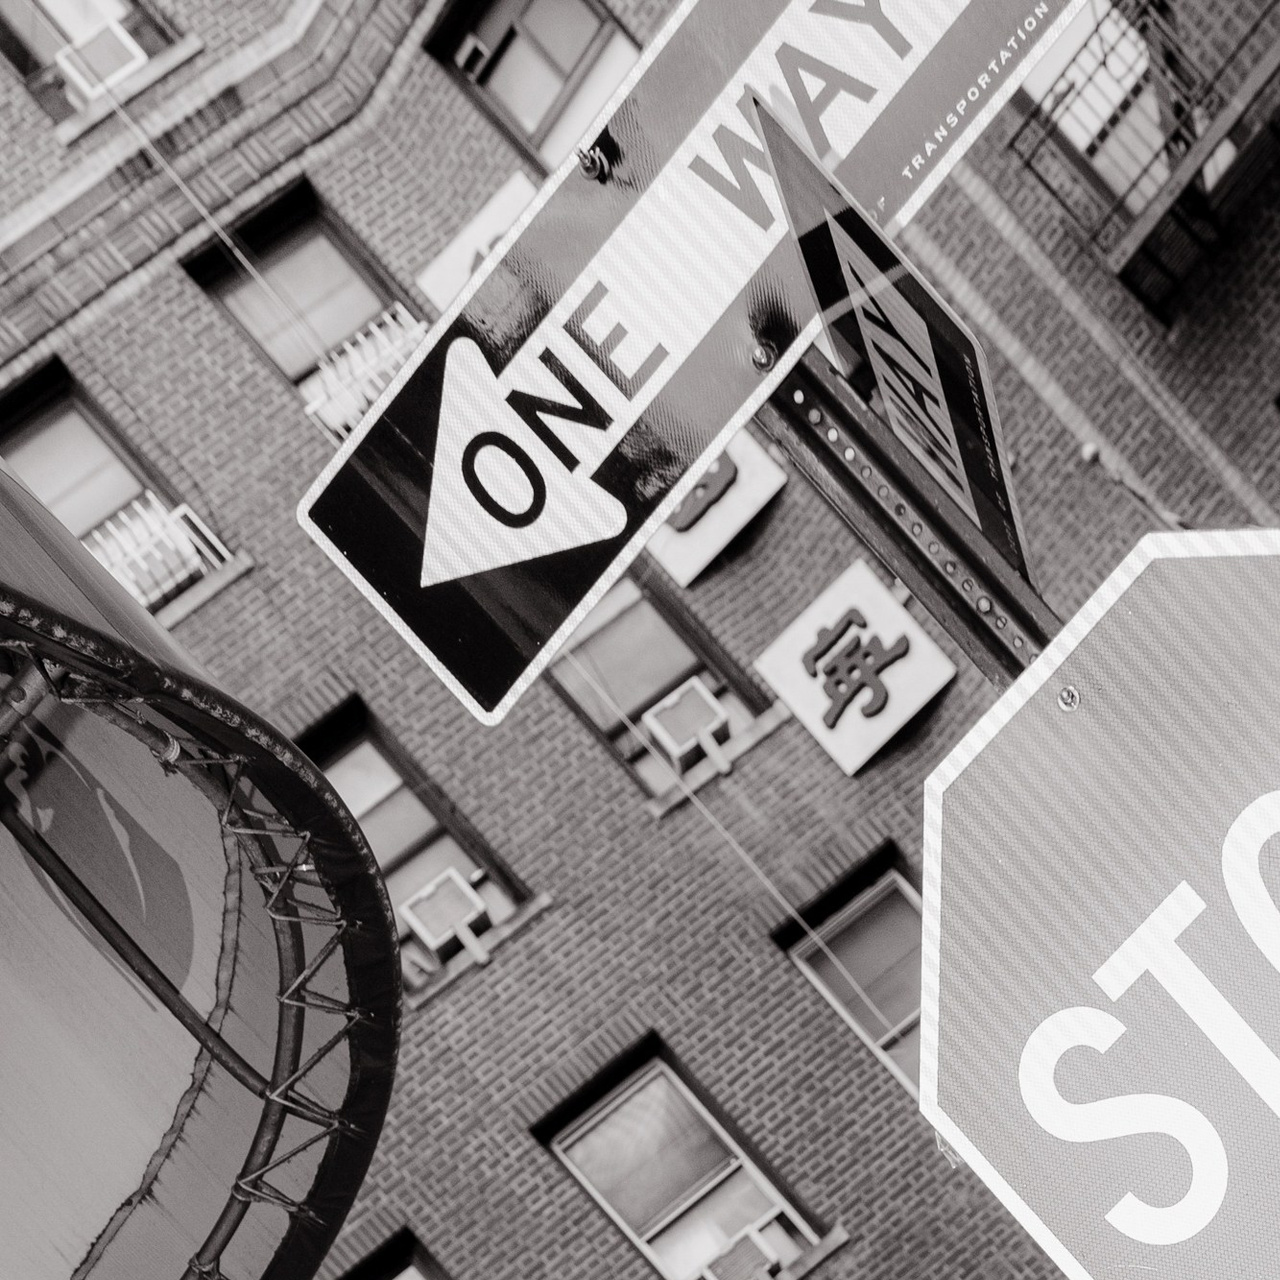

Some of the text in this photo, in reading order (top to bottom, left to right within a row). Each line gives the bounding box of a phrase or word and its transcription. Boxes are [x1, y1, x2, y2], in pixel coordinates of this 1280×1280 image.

[461, 0, 914, 528] ONE WAY
[901, 2, 1050, 182] TRANSPORTATION
